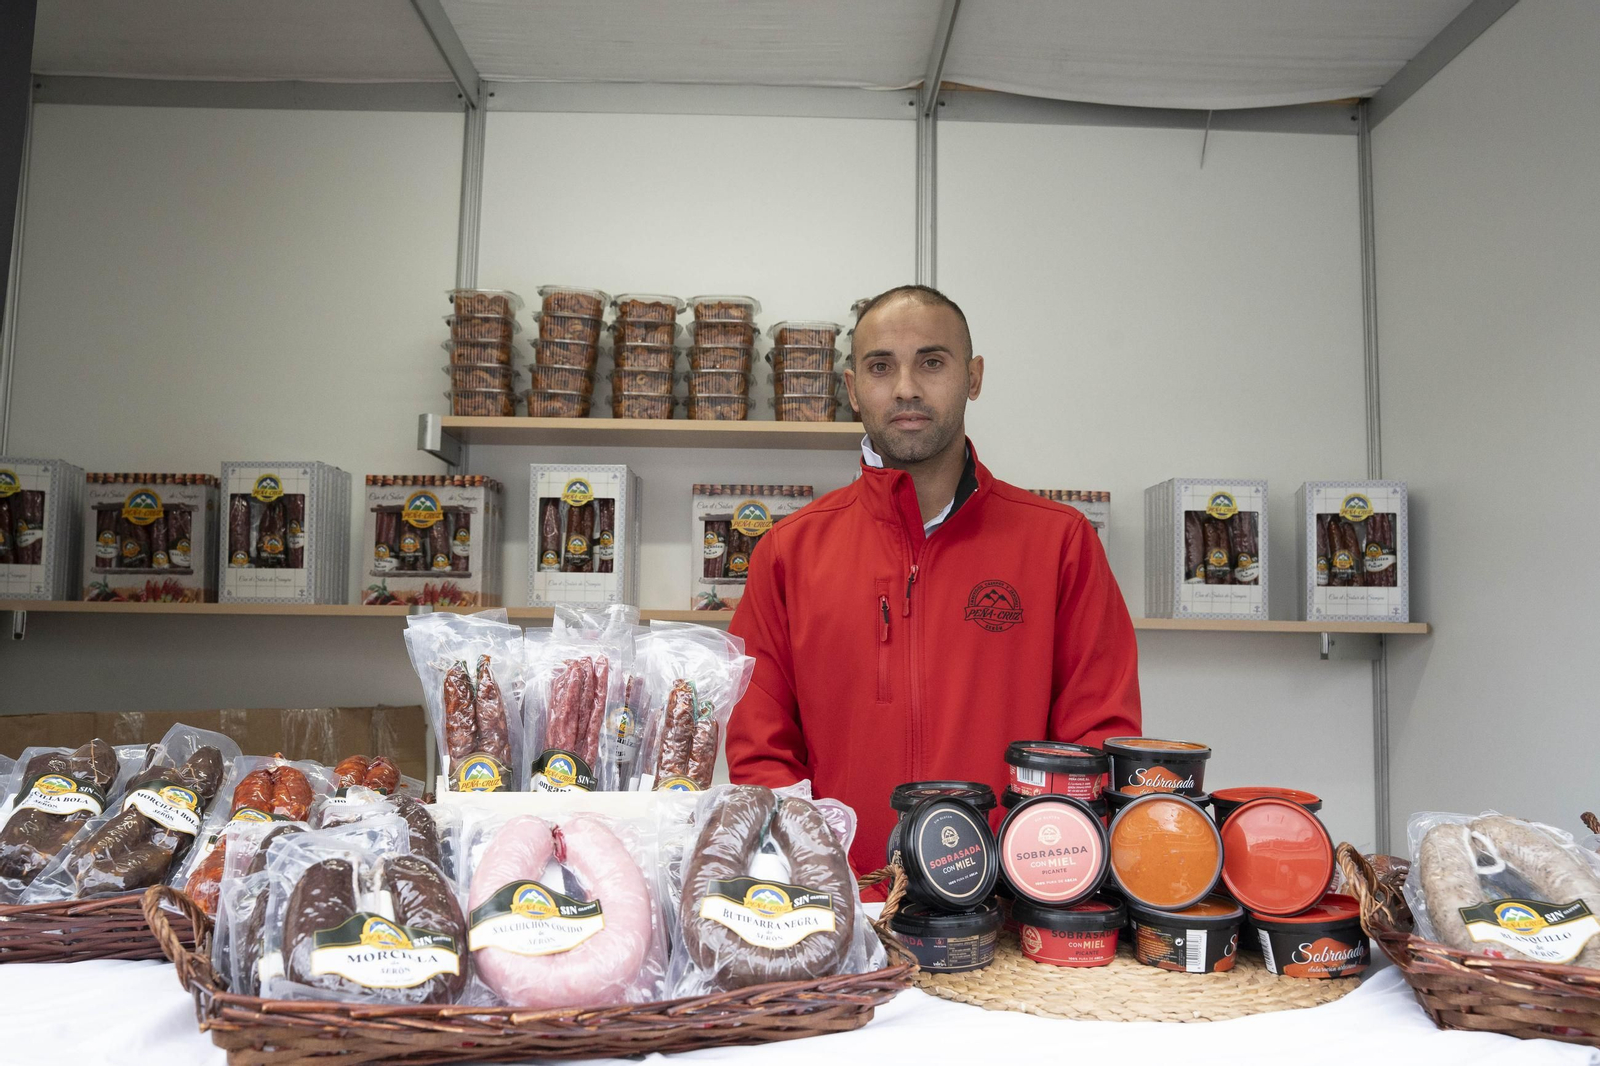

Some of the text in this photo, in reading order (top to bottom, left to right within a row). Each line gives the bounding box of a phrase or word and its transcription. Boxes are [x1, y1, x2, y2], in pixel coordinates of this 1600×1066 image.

[577, 774, 590, 784] SIN
[1128, 768, 1195, 789] Sobrasada
[78, 786, 94, 794] SIN
[137, 792, 180, 815] MORCILLA
[180, 812, 199, 830] BOLA
[929, 844, 982, 870] SOBRASADA
[1016, 846, 1088, 861] SOBRASADA
[942, 857, 976, 874] CON MIEL
[1030, 856, 1076, 868] CON MIEL
[794, 894, 810, 907] SIN
[560, 906, 578, 916] SIN
[1544, 910, 1565, 924] SIN
[492, 918, 583, 934] SALCHICHÓN COCIDO
[723, 908, 818, 930] BUTIFARRA NEGRA
[413, 936, 433, 948] SIN
[1083, 940, 1106, 949] MIEL
[1500, 932, 1572, 944] BLANQUILLO
[1292, 940, 1364, 964] Sobrasada
